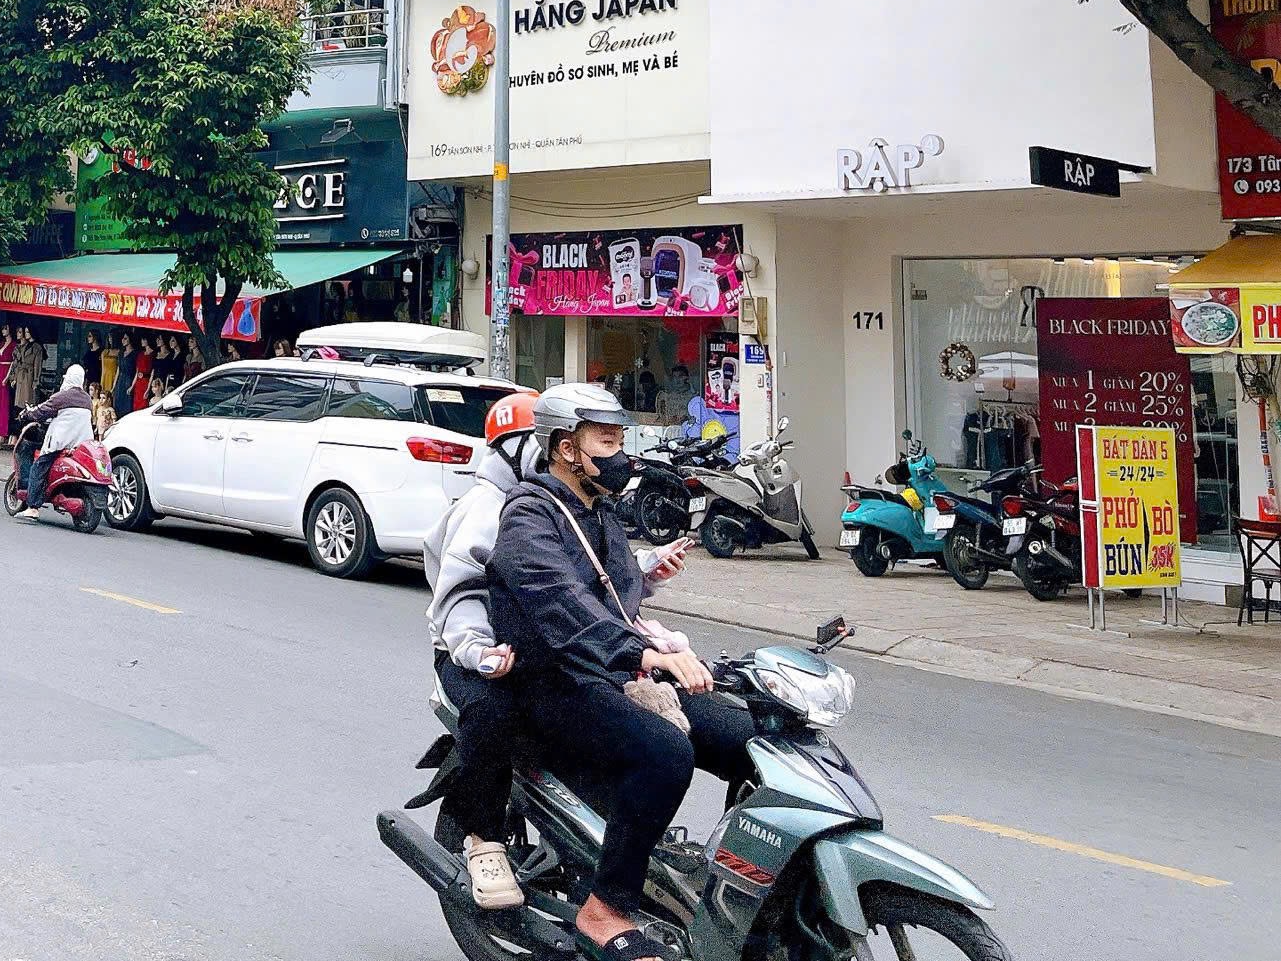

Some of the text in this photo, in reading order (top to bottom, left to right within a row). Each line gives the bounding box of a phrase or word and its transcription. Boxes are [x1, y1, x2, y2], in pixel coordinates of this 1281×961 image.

[586, 26, 677, 55] Premium
[509, 50, 679, 88] HUYÊN ĐỒ SƠ SINH, MẸ VÀ BÉ
[431, 143, 447, 157] 169
[836, 138, 924, 192] RẬP
[1063, 157, 1095, 187] RẬP
[1227, 157, 1252, 173] 173
[1255, 179, 1281, 193] 093
[542, 243, 588, 268] BLACK
[536, 270, 599, 300] FRIDAY
[852, 311, 884, 330] 171
[1049, 319, 1171, 336] BLACK FRIDAY
[1087, 370, 1095, 389] 1
[1139, 371, 1184, 392] 20%
[1084, 392, 1097, 412] 2
[1141, 394, 1184, 416] 25%
[1102, 435, 1129, 460] BÁT
[1160, 440, 1169, 460] 5
[1119, 465, 1155, 482] 24/24
[1102, 487, 1140, 529] PHỞ
[1151, 499, 1174, 536] BÒ
[1104, 536, 1143, 576] BÚN
[738, 815, 782, 849] YAMAHA
